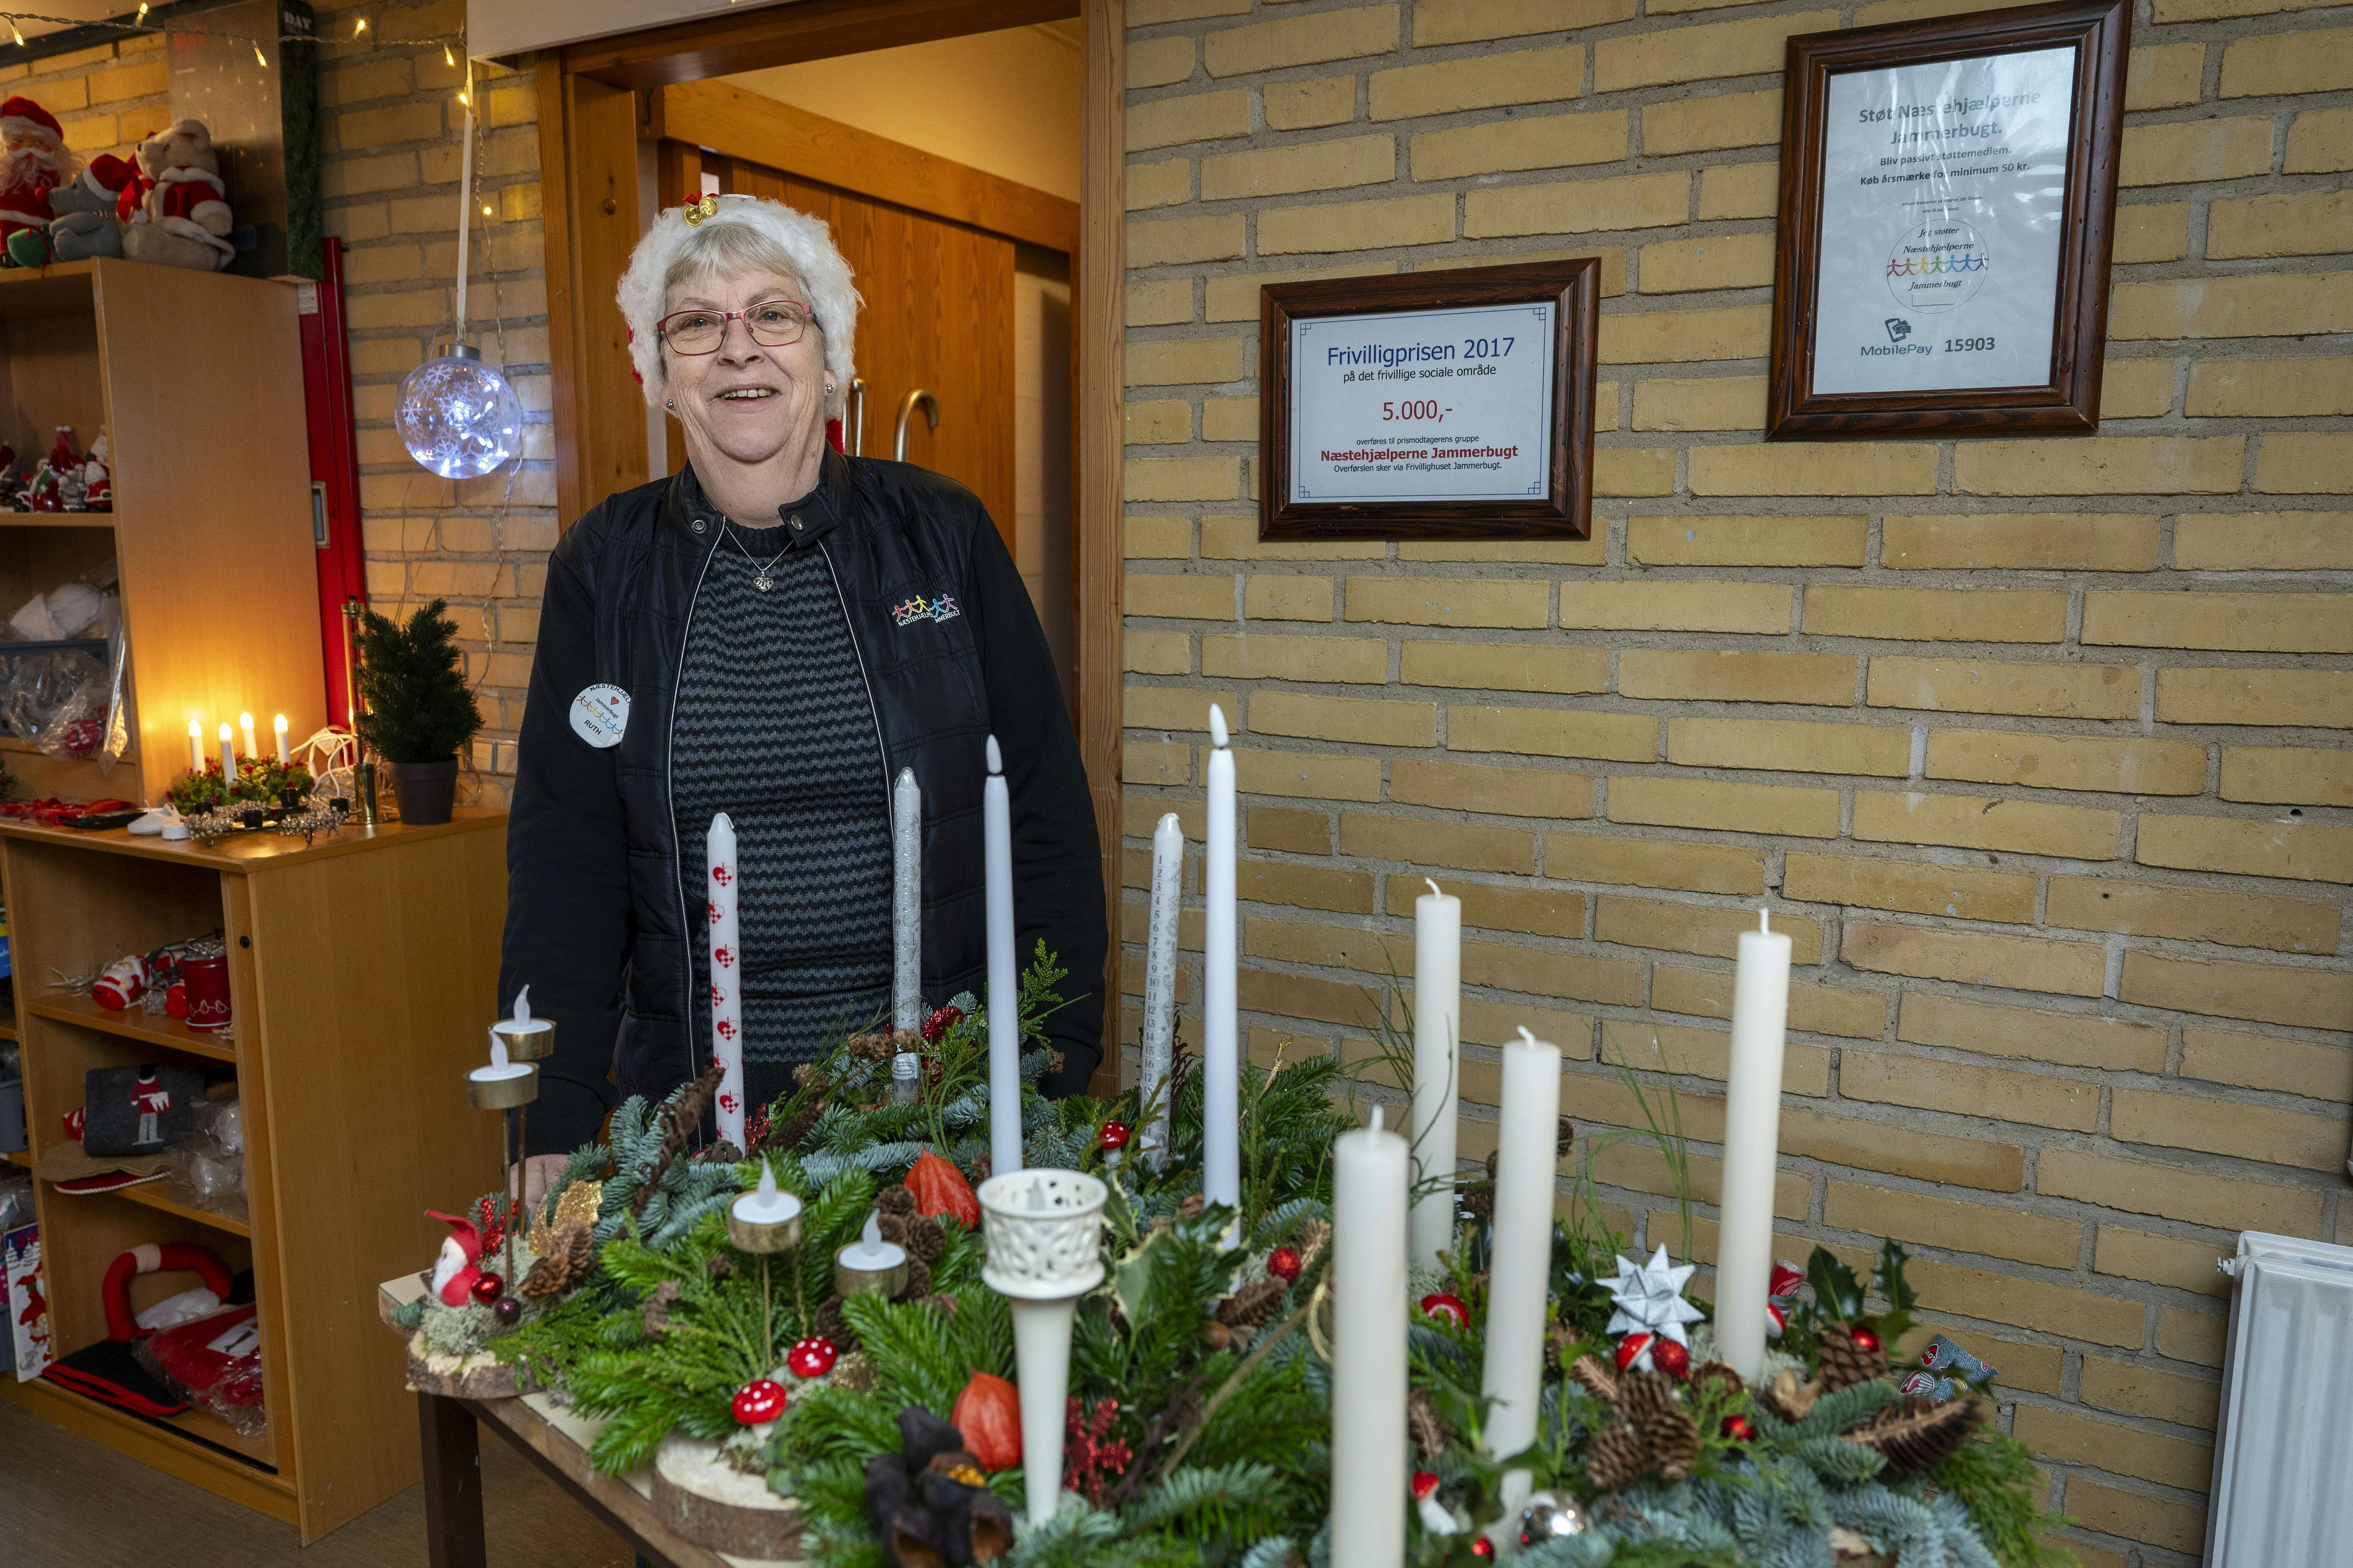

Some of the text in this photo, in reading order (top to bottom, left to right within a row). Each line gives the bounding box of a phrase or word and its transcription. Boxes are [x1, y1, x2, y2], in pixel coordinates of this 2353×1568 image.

[1859, 92, 2041, 123] Støt Næsehjælperne
[1890, 121, 2002, 144] Jammerbugt.
[1880, 147, 2011, 166] Bliv passivt støttemedlem.
[1860, 175, 1879, 186] Køb
[1881, 171, 1930, 183] årsmærke
[1950, 166, 1999, 177] minimum
[2001, 163, 2014, 172] 50
[2017, 162, 2030, 171] kr.
[1918, 229, 1933, 238] Jeg
[1902, 243, 1975, 254] Næstehjælperne
[1908, 279, 1962, 291] Jammerbugt
[1861, 337, 1995, 356] MobilePay 15903
[1328, 337, 1515, 367] Frivilligprisen 2017
[1343, 364, 1496, 384] på det frivillige sociale område
[1383, 400, 1453, 423] 5.000,-
[1397, 436, 1453, 445] prismodtagerens
[1455, 436, 1479, 444] gruppe
[1321, 445, 1518, 463] Næstehjælperne Jammerbugt
[1334, 464, 1374, 473] Overførslen
[1406, 462, 1451, 472] Frivillighuset
[1453, 461, 1502, 470] Jammerbugt.
[595, 697, 619, 719] Jammerbugt
[584, 720, 602, 735] RUTH
[1156, 868, 1162, 877] 2
[1156, 882, 1161, 891] 3
[1154, 910, 1160, 919] 5
[1153, 923, 1159, 932] 6
[1153, 937, 1158, 946] 7
[1152, 950, 1157, 959] 8
[1151, 964, 1158, 973] 9
[1150, 977, 1160, 987] 10
[1148, 992, 1156, 1001] 11
[1148, 1005, 1156, 1014] 12
[1147, 1018, 1155, 1028] 13
[1146, 1032, 1154, 1041] 14
[1145, 1059, 1154, 1068] 16
[1925, 1348, 1936, 1362] LOVE
